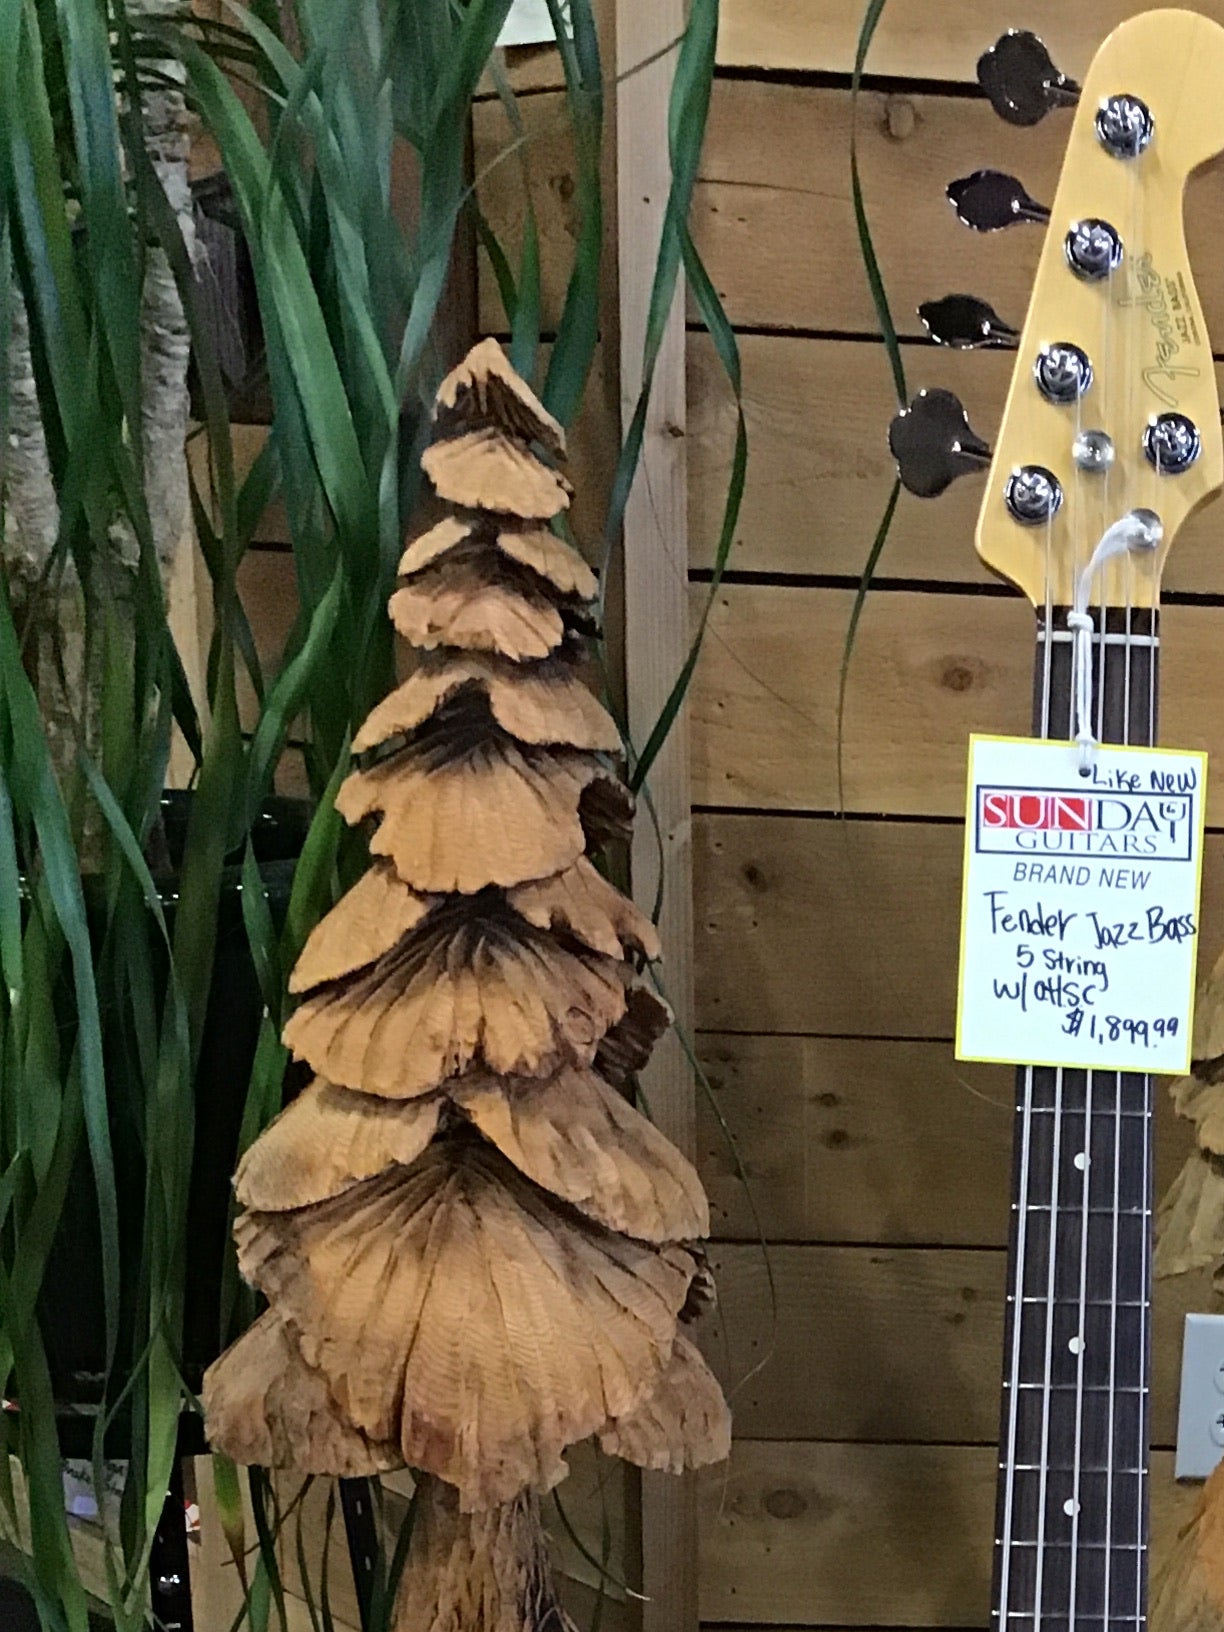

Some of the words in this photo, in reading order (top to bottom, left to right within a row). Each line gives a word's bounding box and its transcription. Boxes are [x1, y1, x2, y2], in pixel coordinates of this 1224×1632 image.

[1117, 251, 1201, 408] Fender
[984, 793, 1187, 844] SUNDAY
[1015, 831, 1157, 854] GUITARS
[1013, 862, 1091, 886] BRAND
[1099, 868, 1151, 890] NEW
[983, 891, 1078, 941] Fender
[1085, 912, 1144, 949] Jazz
[1146, 905, 1197, 944] Bass
[1016, 944, 1035, 968] 5
[1042, 948, 1109, 992] String
